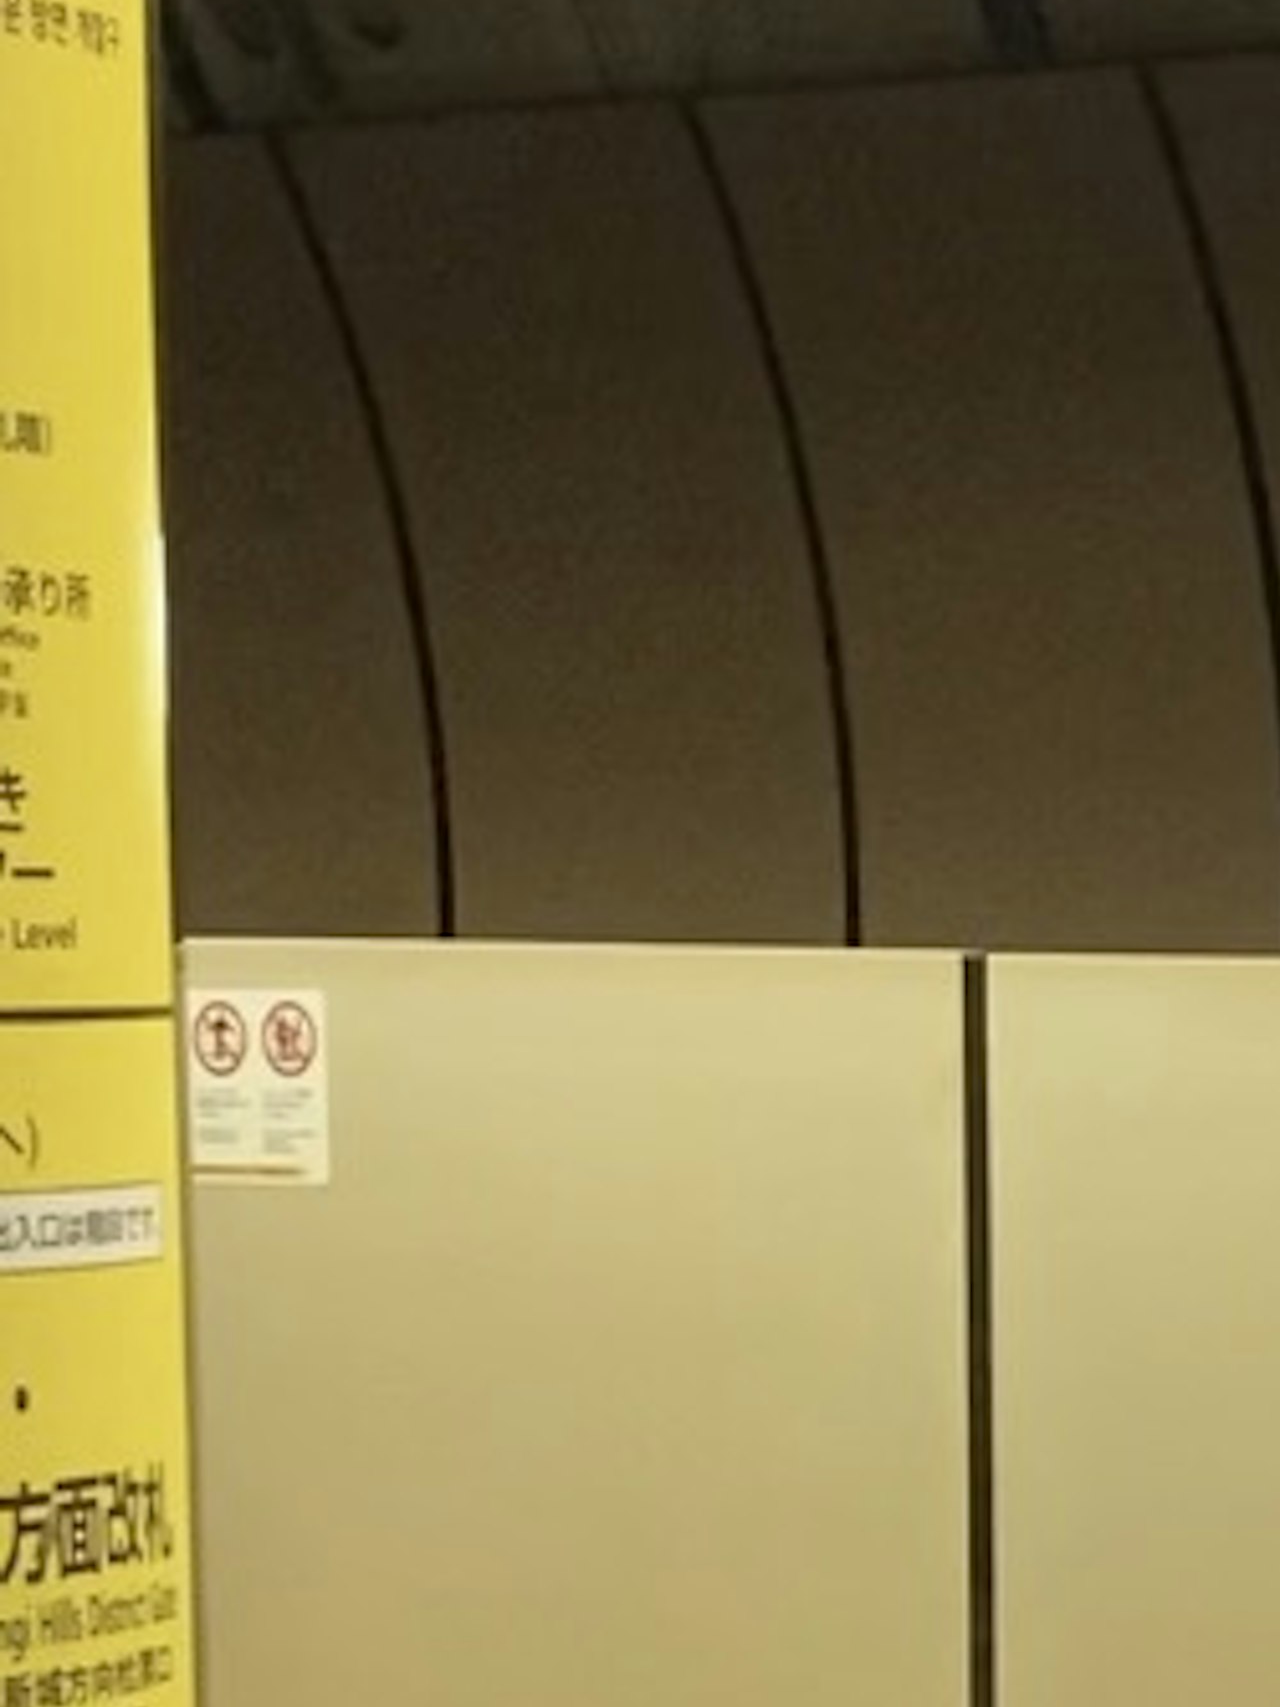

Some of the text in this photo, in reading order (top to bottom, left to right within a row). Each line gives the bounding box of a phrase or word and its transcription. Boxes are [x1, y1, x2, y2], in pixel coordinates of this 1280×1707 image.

[10, 916, 78, 950] Level
[0, 1460, 173, 1582] 方面改札
